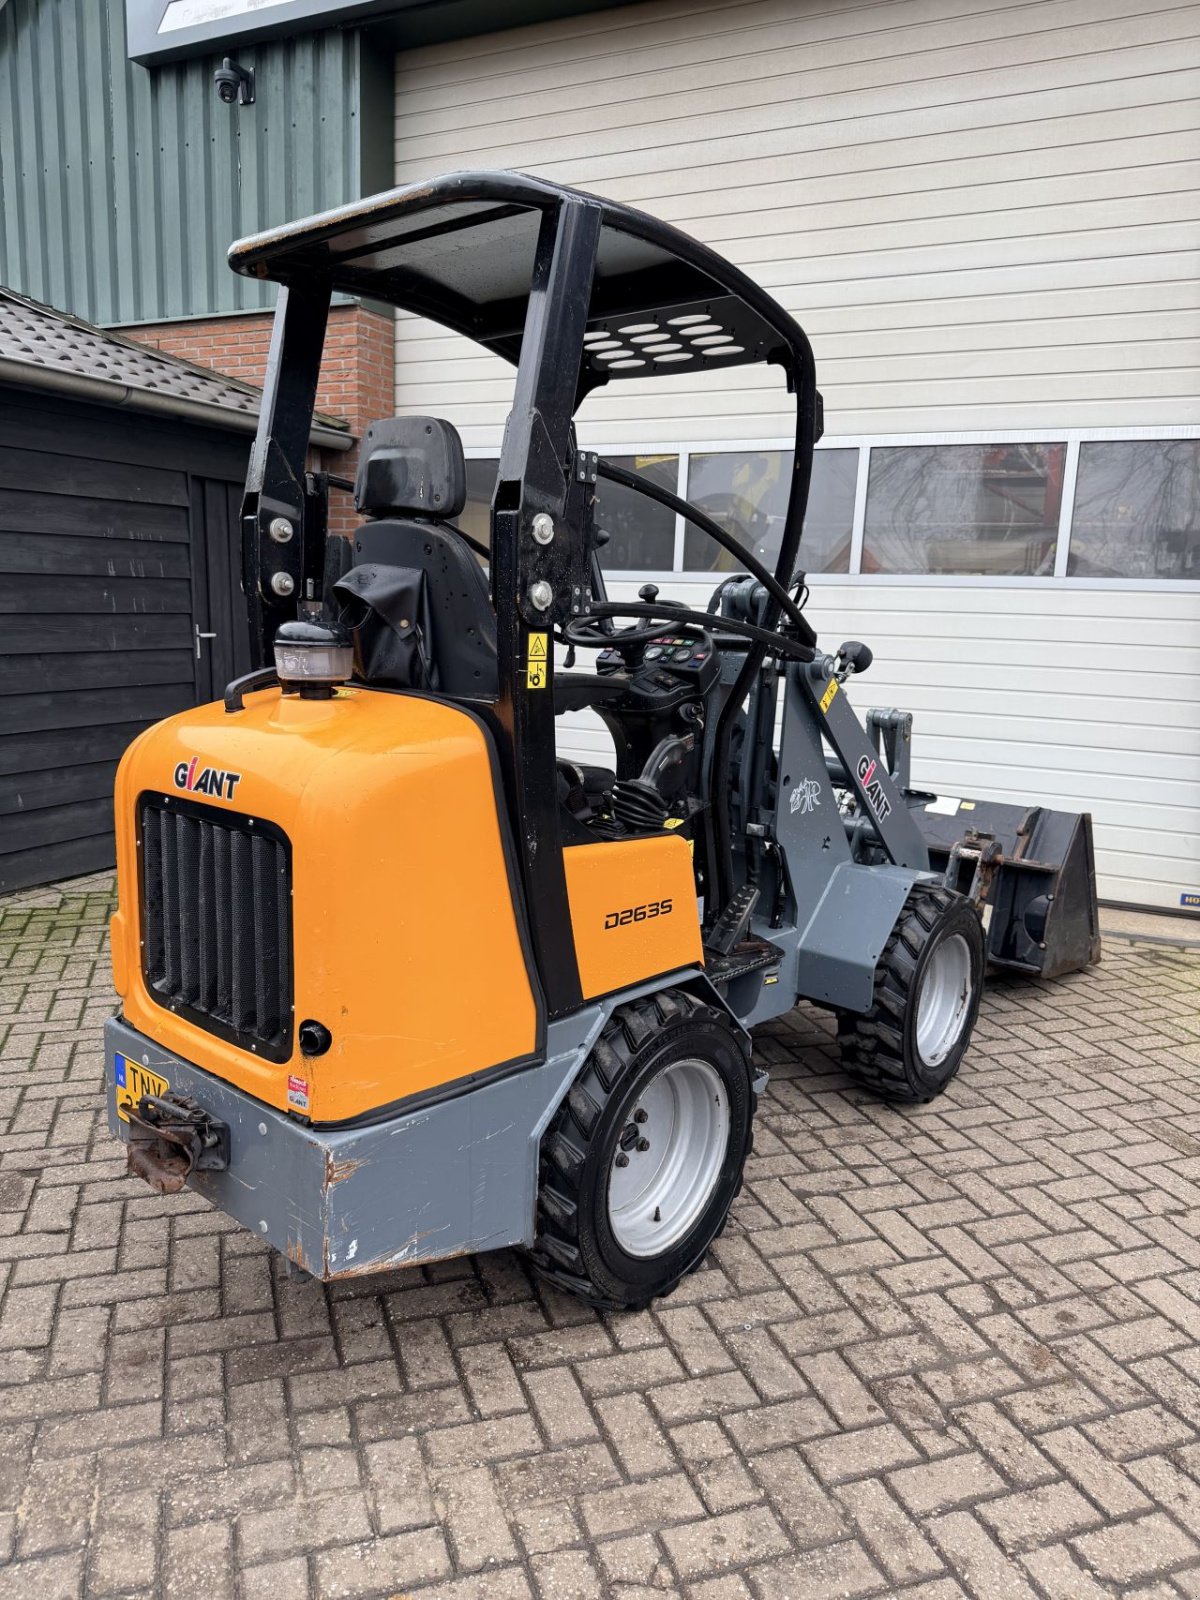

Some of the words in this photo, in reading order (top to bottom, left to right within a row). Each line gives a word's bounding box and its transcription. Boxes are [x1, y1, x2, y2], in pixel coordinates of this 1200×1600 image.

[174, 756, 241, 800] GIANT
[857, 755, 892, 823] GIANT
[604, 898, 673, 930] D263S
[130, 1066, 162, 1098] TNV
